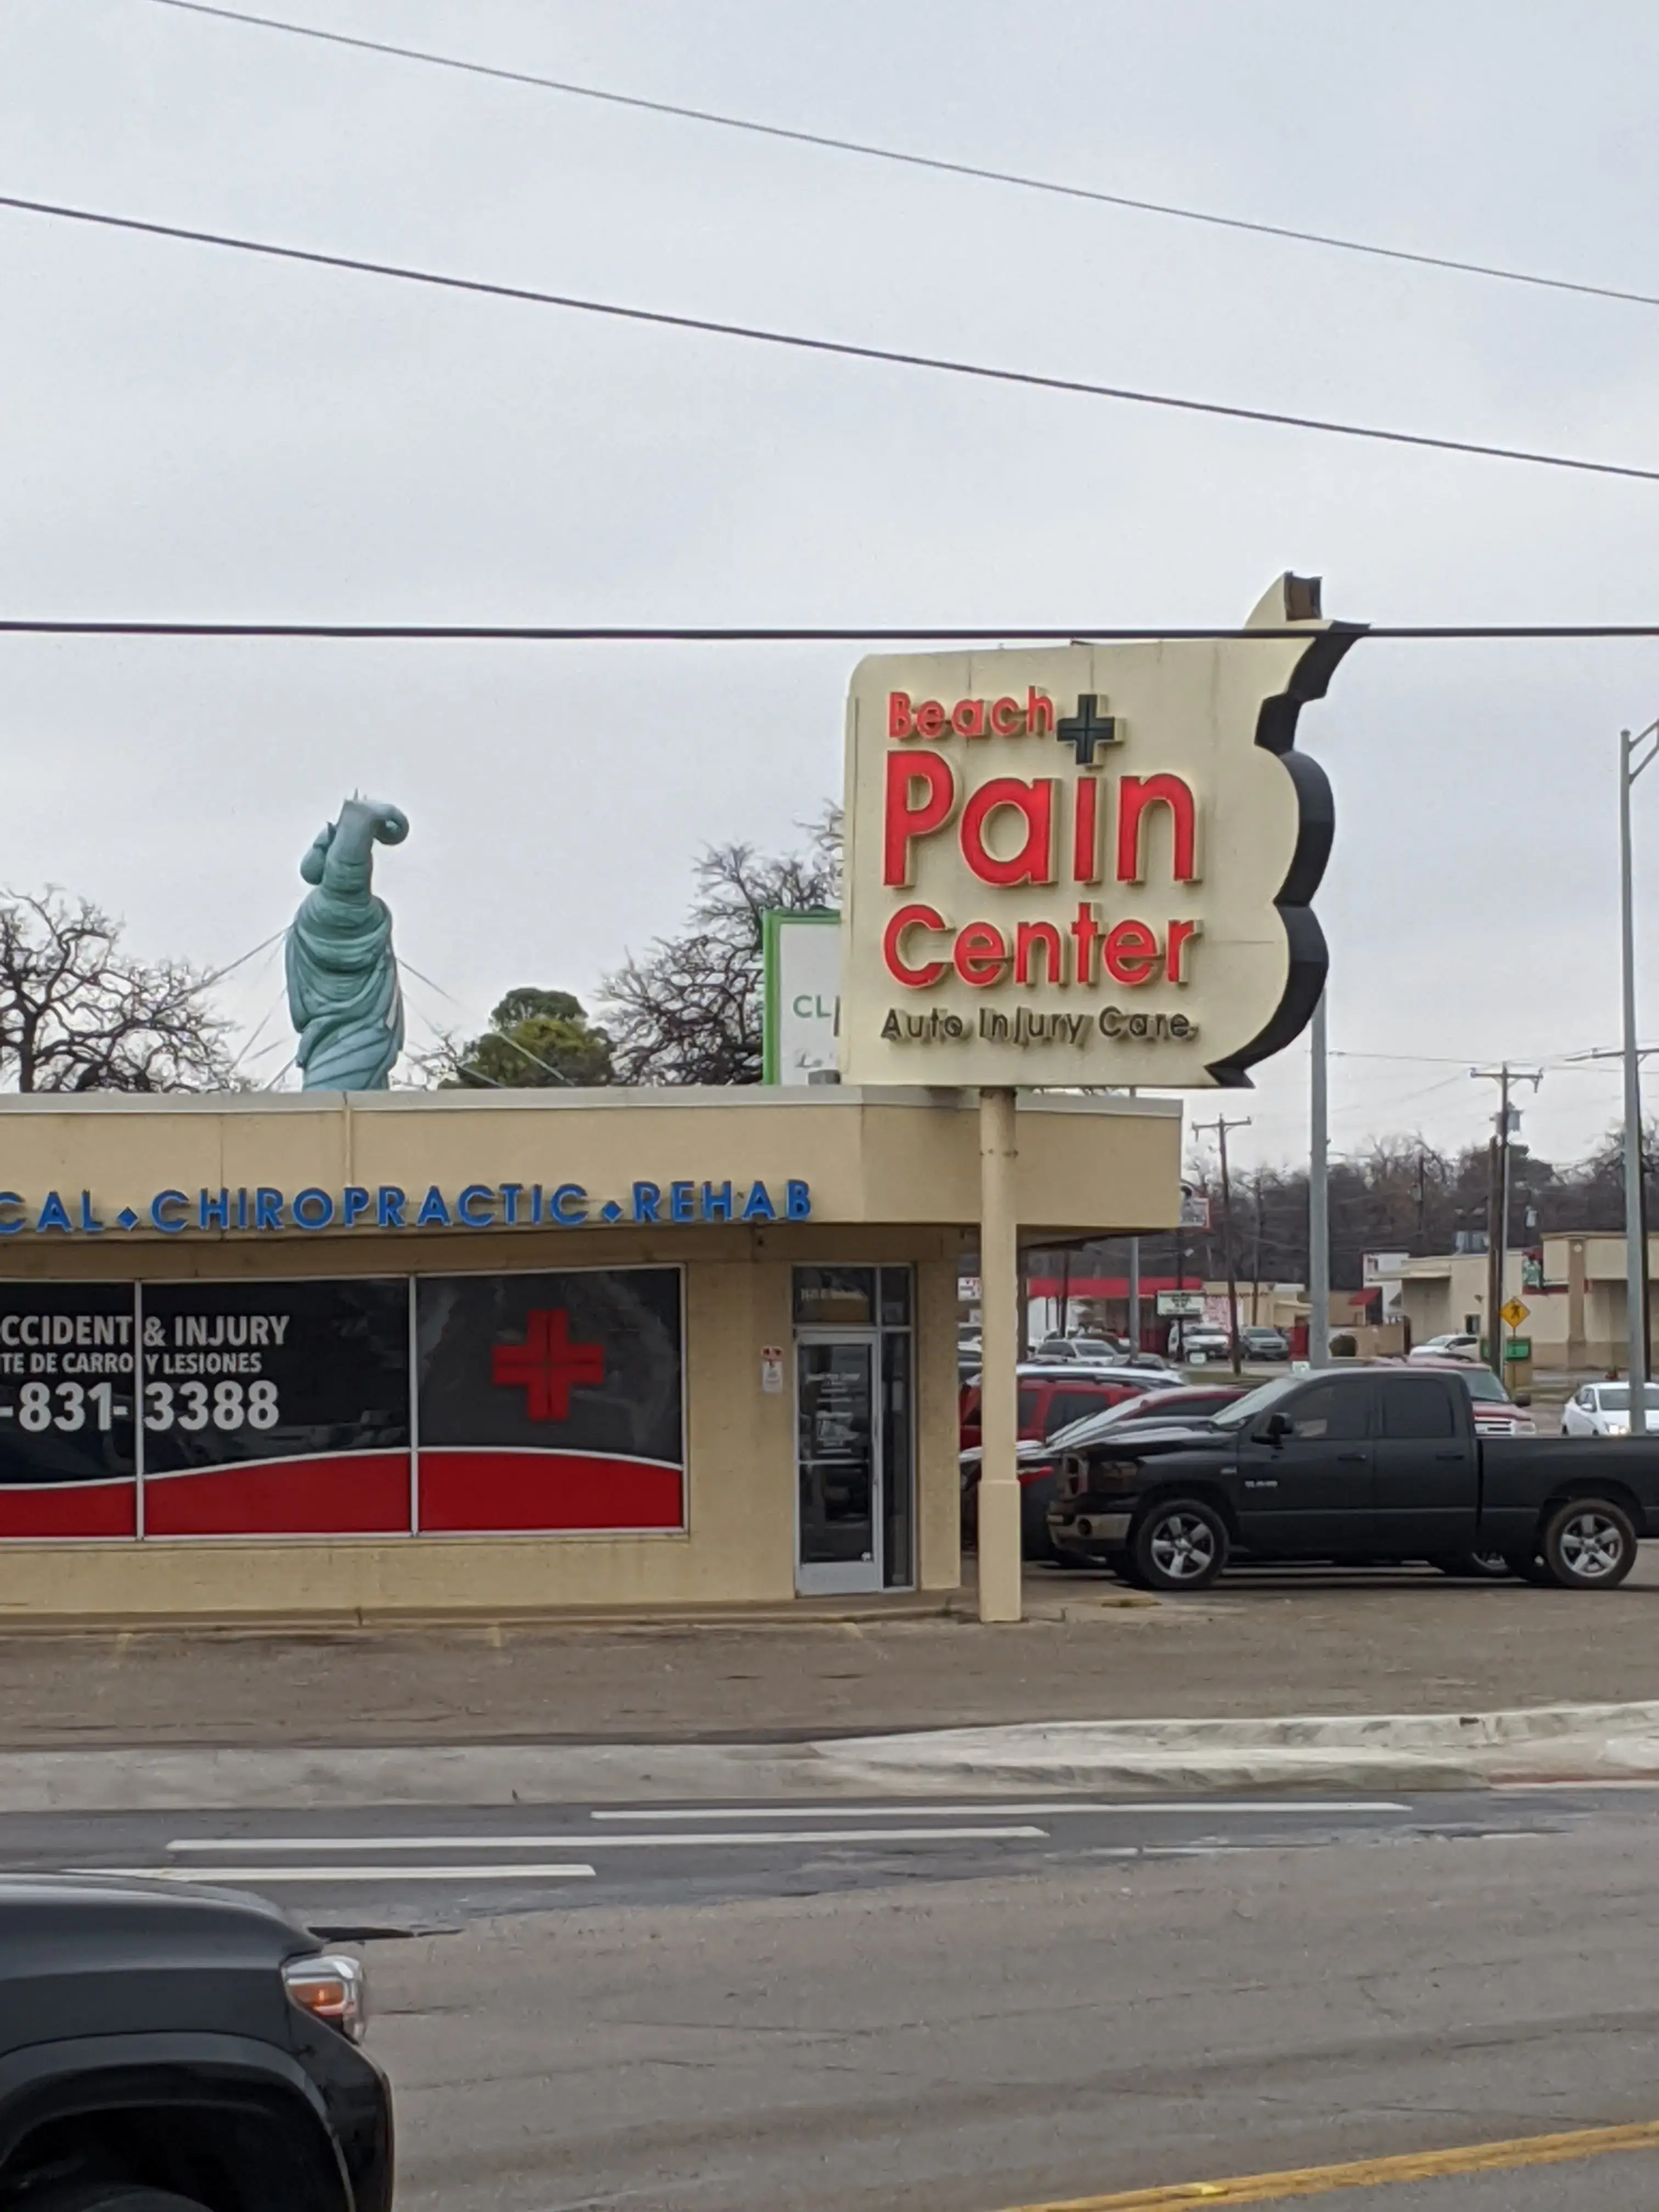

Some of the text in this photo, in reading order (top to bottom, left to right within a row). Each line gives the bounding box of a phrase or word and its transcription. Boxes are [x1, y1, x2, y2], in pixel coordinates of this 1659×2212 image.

[888, 686, 1054, 738] Beach
[883, 749, 1198, 887] Pain
[883, 902, 1198, 987] Center
[881, 1008, 963, 1038] Auto
[1099, 1005, 1190, 1039] Care
[151, 1183, 588, 1232] CHIROPRACTIC
[632, 1178, 812, 1223] REHAB
[1, 1315, 290, 1347] CCIDENT & INJURY
[30, 1352, 58, 1374] DE
[61, 1352, 134, 1374] CARRO
[144, 1352, 159, 1375] Y
[162, 1352, 262, 1375] LESIONES
